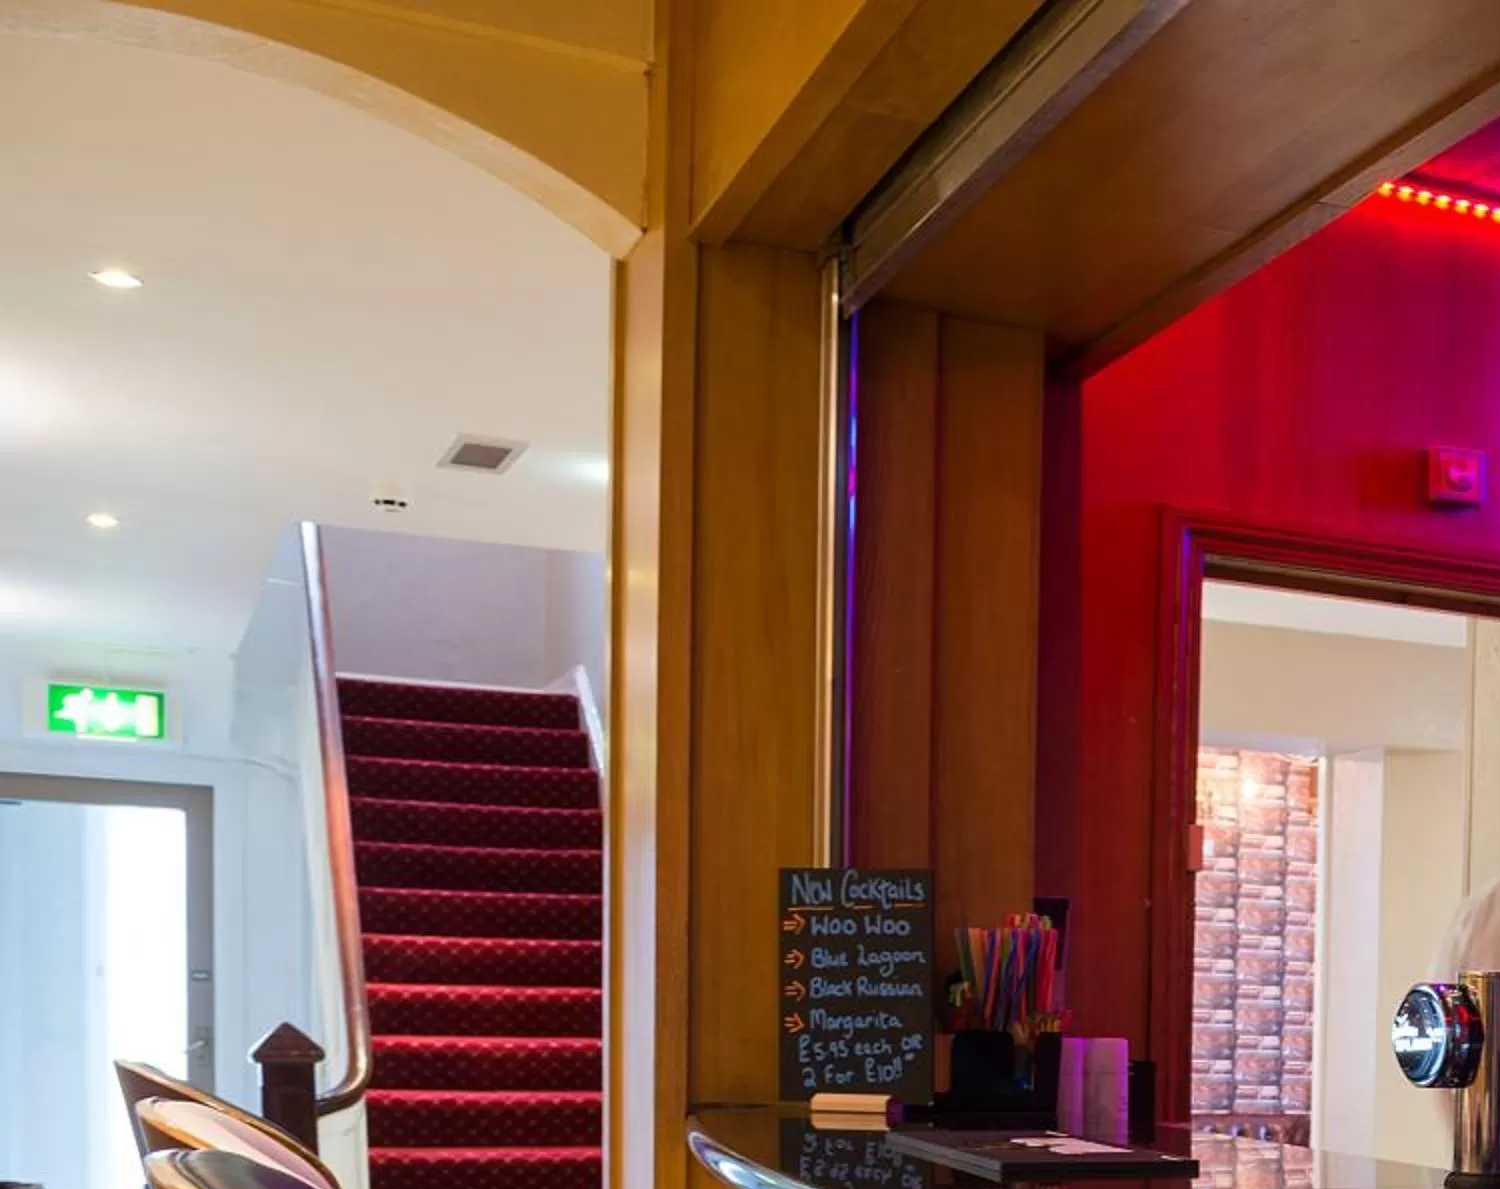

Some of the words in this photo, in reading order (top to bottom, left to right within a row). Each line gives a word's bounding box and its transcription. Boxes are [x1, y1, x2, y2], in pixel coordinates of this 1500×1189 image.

[841, 870, 925, 910] Cocktails
[810, 947, 849, 969] Blue
[856, 943, 926, 977] Lagoon
[809, 976, 854, 999] Black
[856, 975, 924, 997] Russian
[809, 1007, 904, 1040] Margarita
[854, 1038, 892, 1057] each
[801, 1066, 817, 1088] 2
